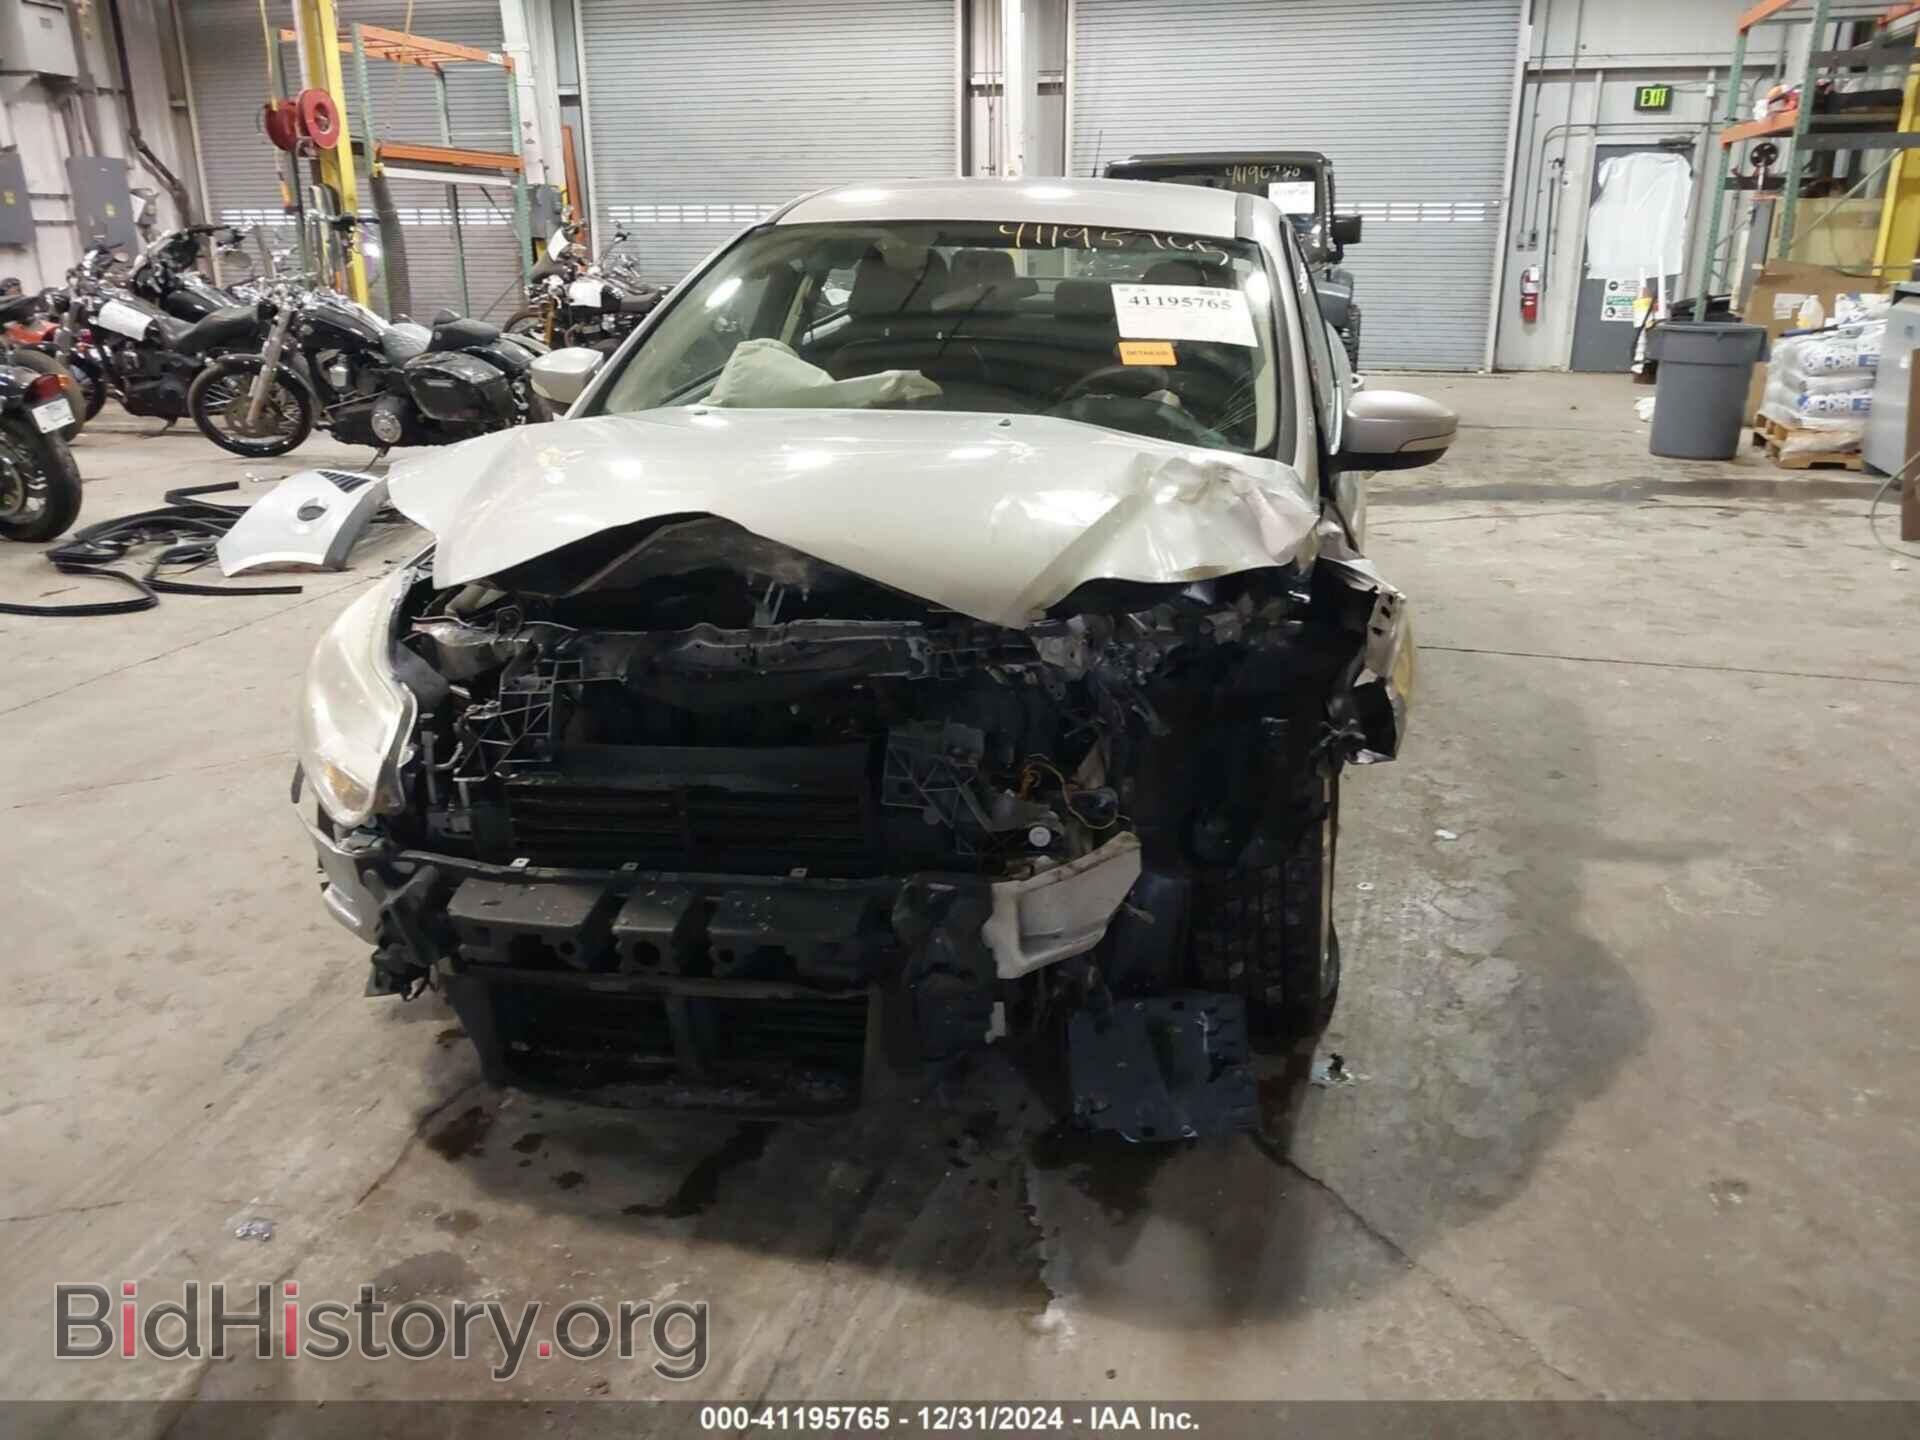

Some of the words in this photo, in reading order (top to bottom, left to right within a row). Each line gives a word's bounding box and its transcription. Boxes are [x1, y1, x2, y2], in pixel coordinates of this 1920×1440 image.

[1640, 87, 1669, 107] EXIT
[999, 222, 1229, 266] 41195765
[1128, 295, 1233, 311] 41195765
